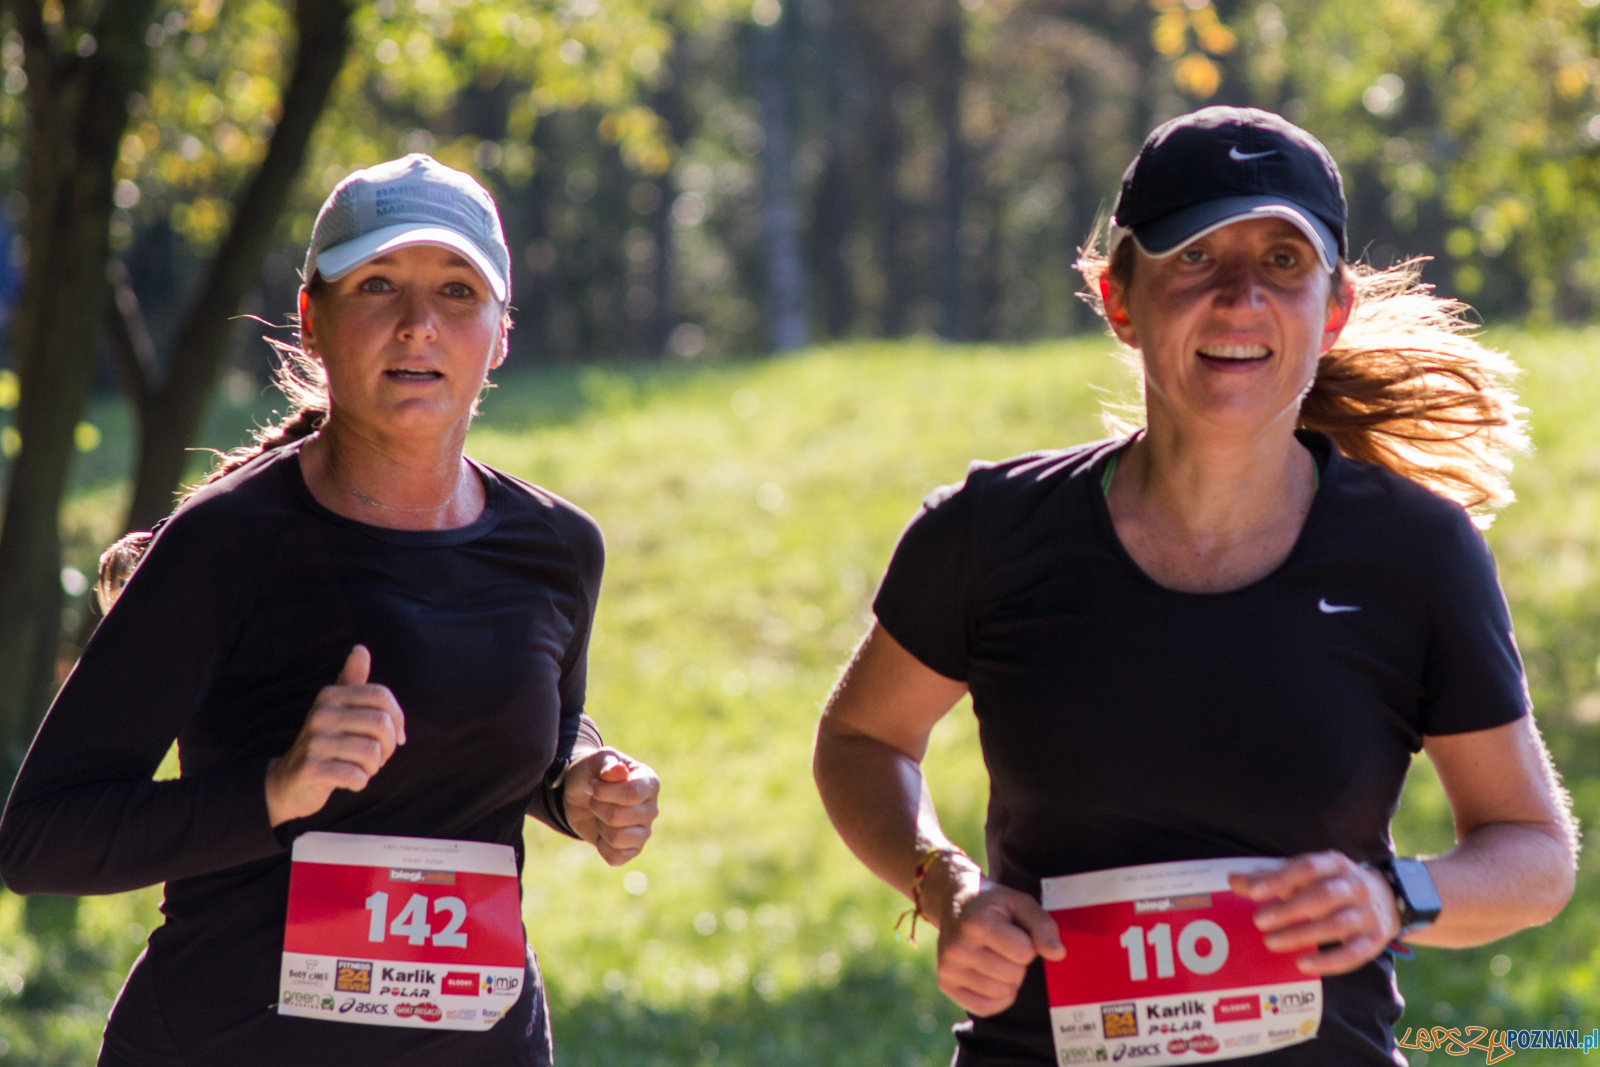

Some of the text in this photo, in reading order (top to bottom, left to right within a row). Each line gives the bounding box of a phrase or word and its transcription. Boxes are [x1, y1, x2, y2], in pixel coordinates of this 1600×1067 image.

[365, 890, 468, 949] 142
[1120, 918, 1229, 982] 110
[338, 962, 371, 971] FITNESS
[339, 968, 370, 984] 24
[381, 967, 436, 984] Karlik
[495, 975, 519, 991] mjp
[337, 981, 370, 992] SEVEN
[379, 986, 430, 998] POLAR
[282, 990, 320, 1005] green
[1283, 990, 1315, 1007] mjp
[1146, 1000, 1205, 1019] Karlik
[1104, 1012, 1135, 1029] 24
[1148, 1020, 1202, 1035] POLAR
